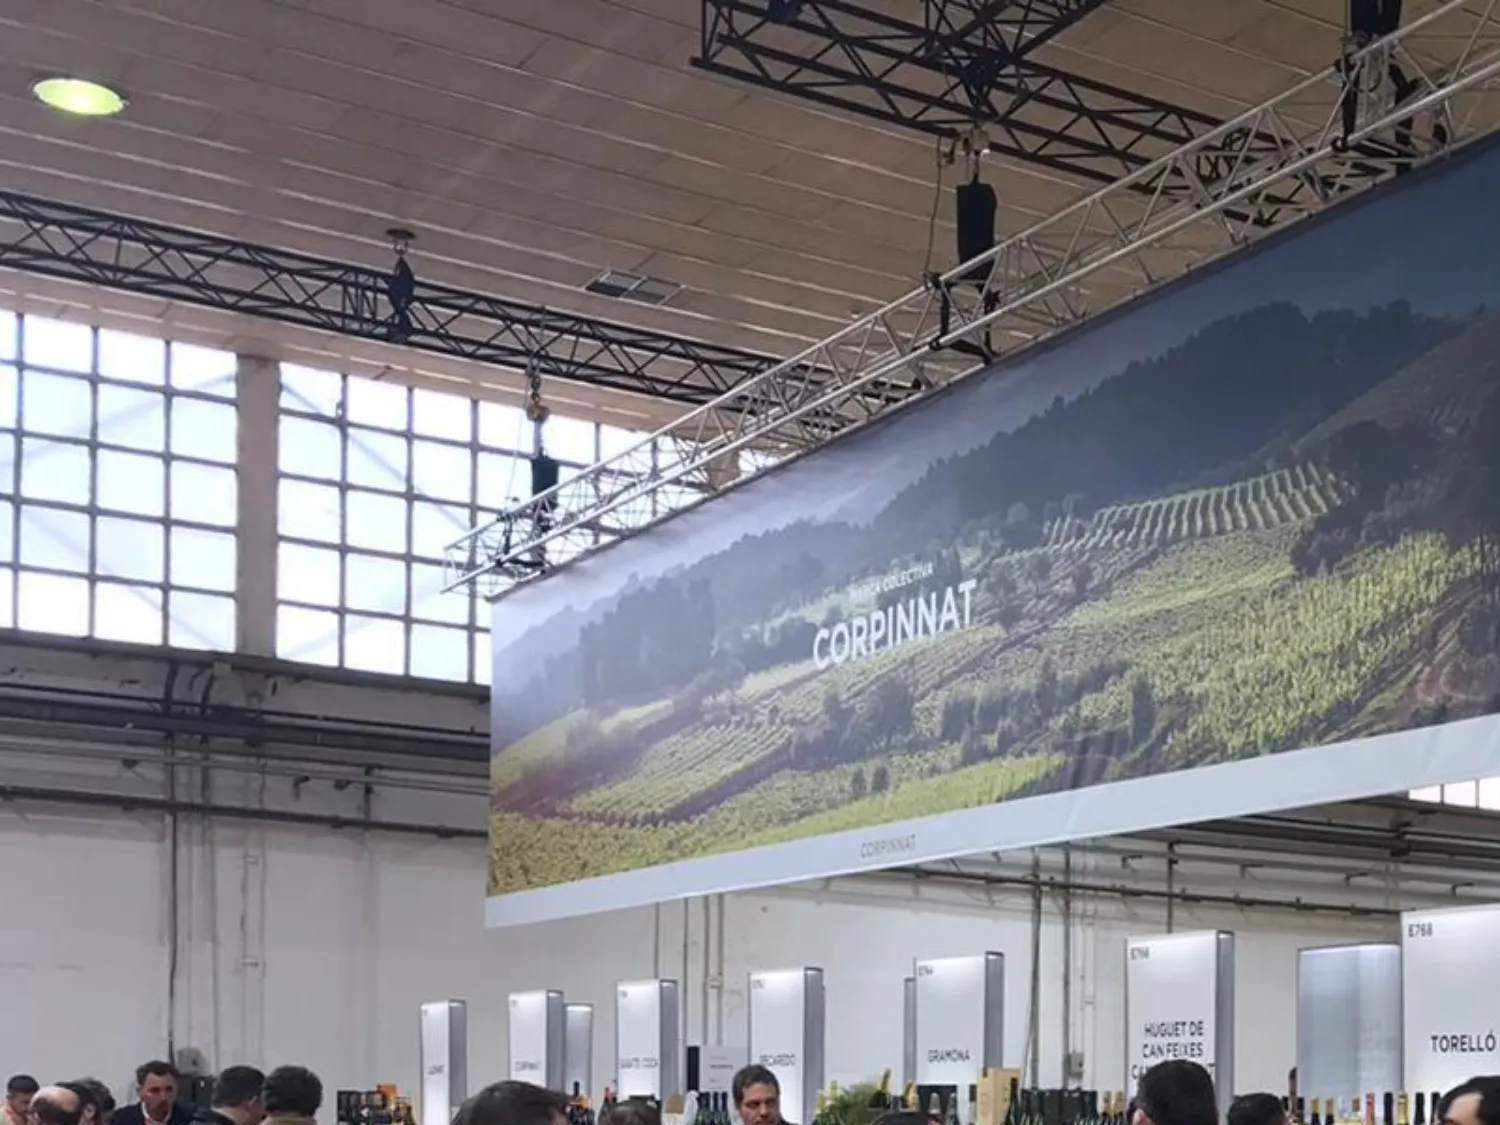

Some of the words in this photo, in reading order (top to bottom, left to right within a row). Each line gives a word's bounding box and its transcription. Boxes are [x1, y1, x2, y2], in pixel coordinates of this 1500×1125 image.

[812, 578, 977, 670] CORPINNAT
[860, 833, 916, 859] CORPINNAT
[1144, 1021, 1187, 1038] HUGUET
[1189, 1020, 1204, 1037] DE
[1166, 1041, 1204, 1058] FEIXES
[1430, 1028, 1497, 1052] TORELLÓ
[928, 1049, 971, 1063] GRAMONA
